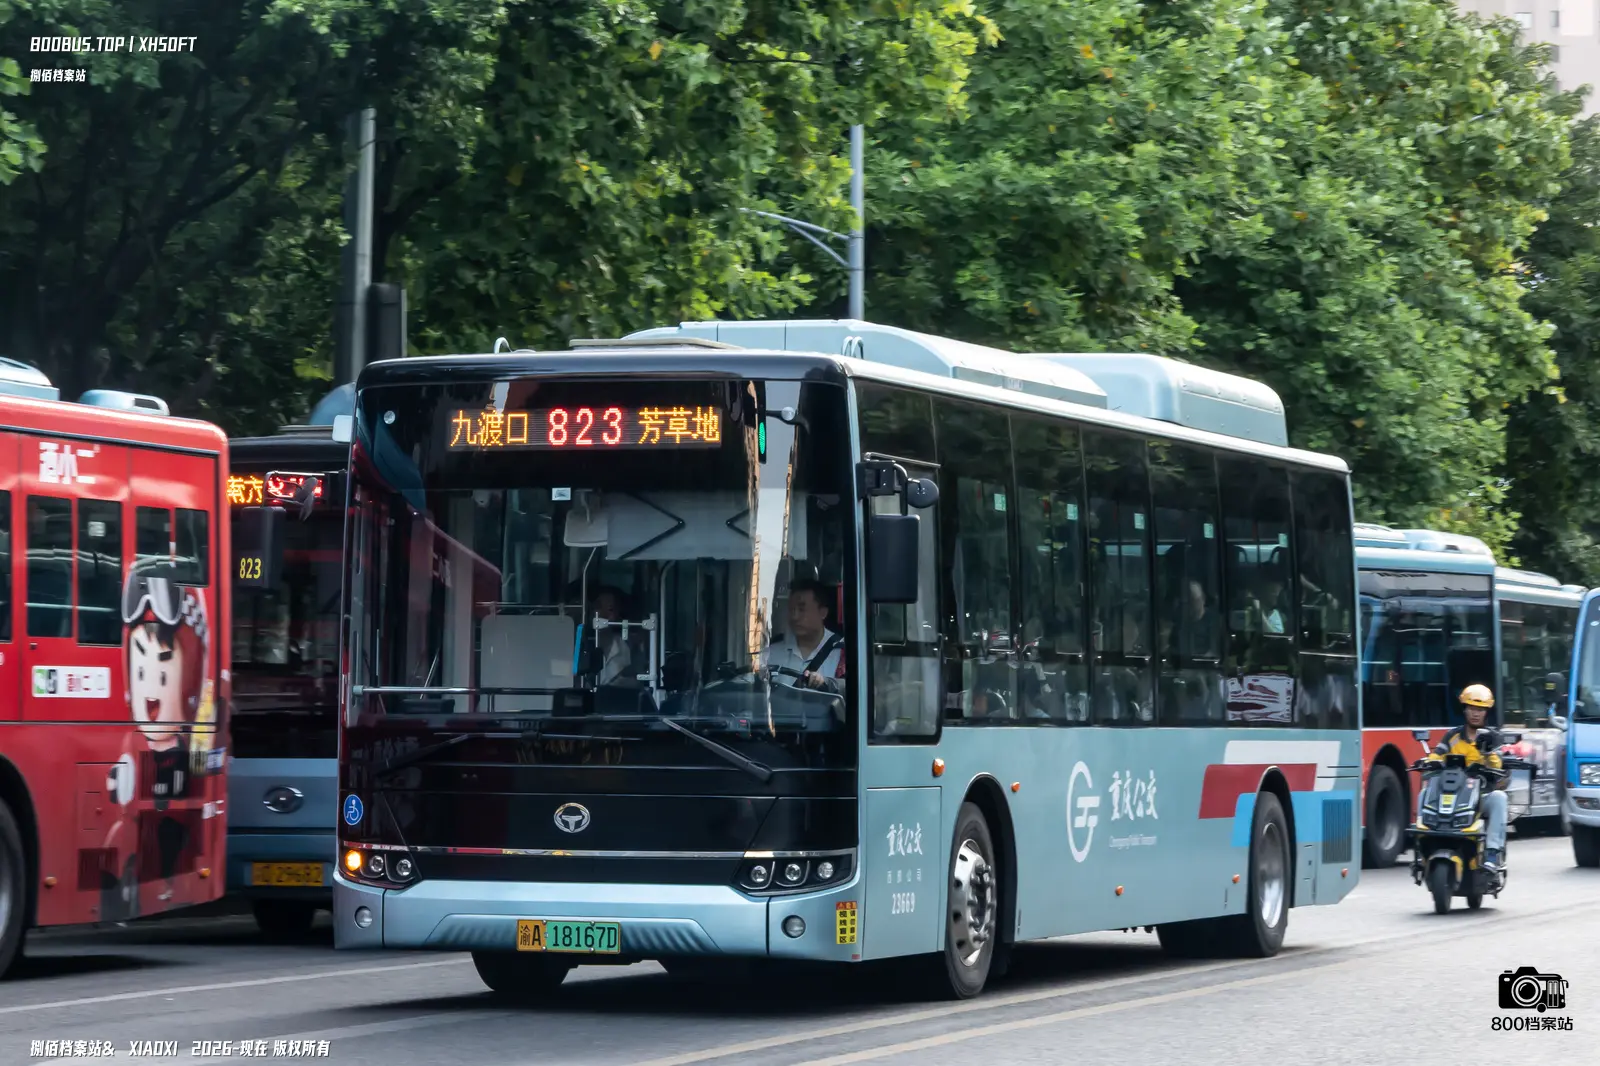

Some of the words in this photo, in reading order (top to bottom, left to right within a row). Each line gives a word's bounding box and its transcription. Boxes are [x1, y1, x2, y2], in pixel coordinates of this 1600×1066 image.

[450, 410, 528, 446] 九渡口
[548, 408, 622, 445] 823
[639, 407, 719, 444] 芳草地
[239, 558, 262, 579] 823
